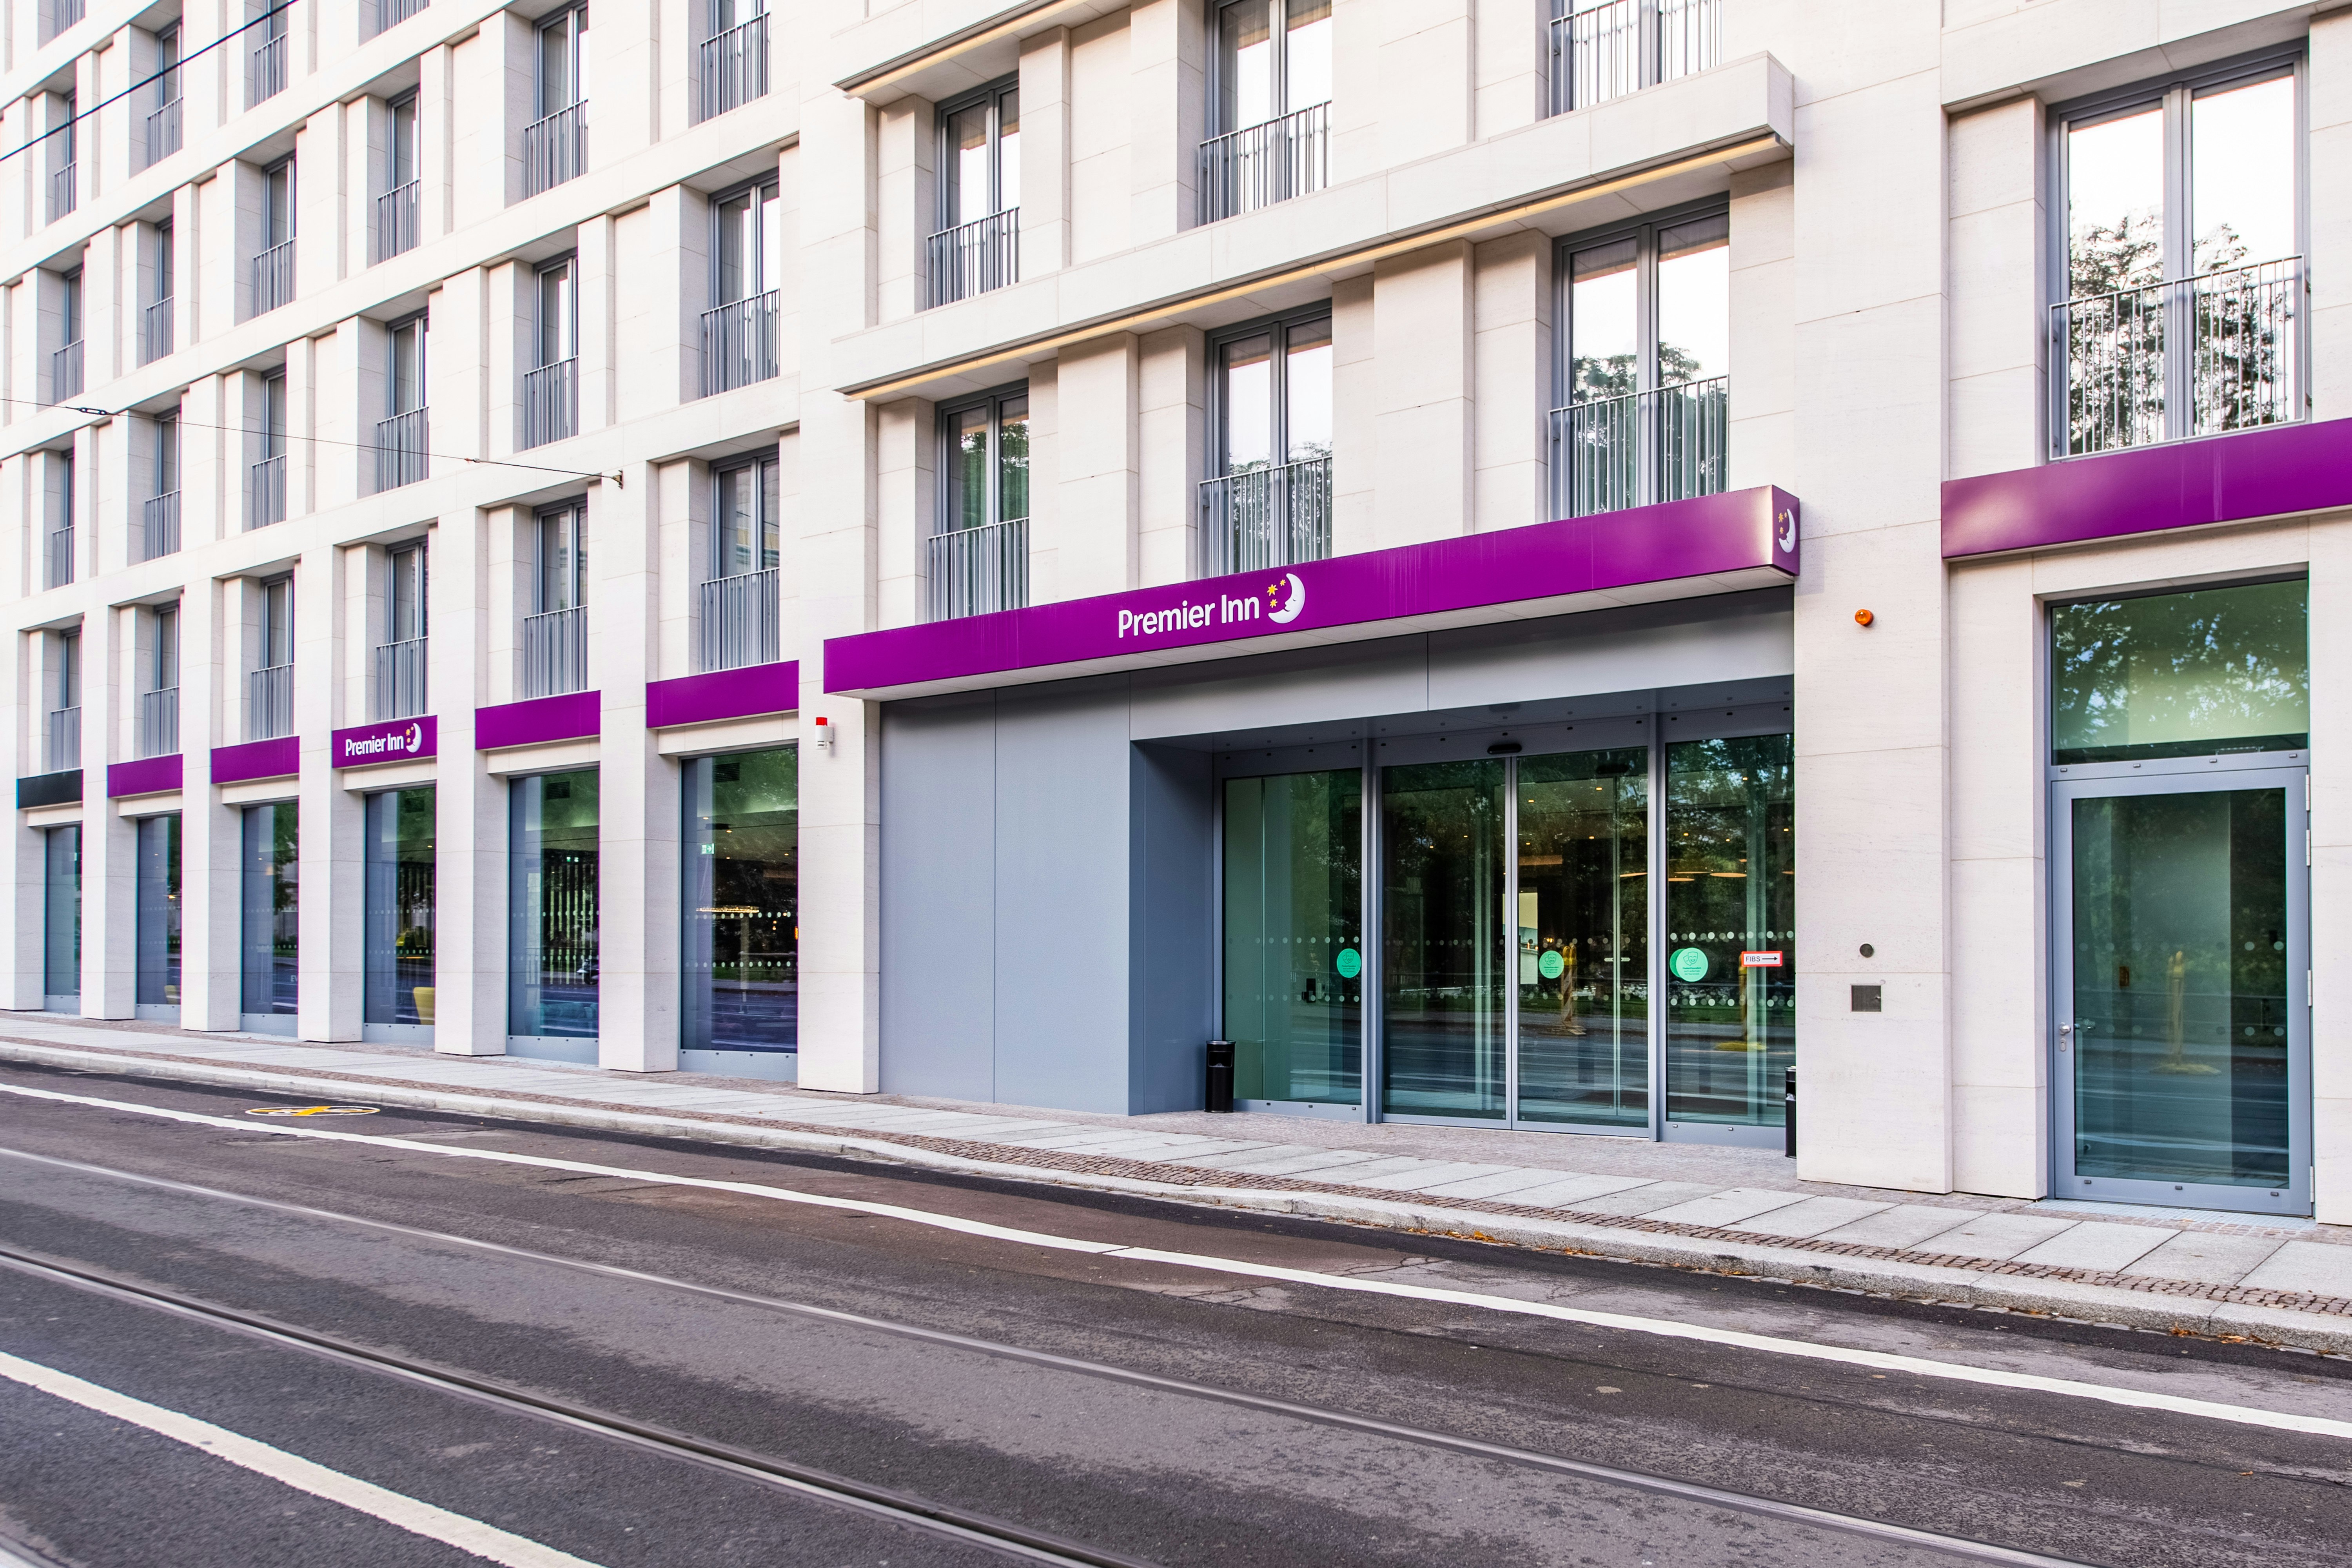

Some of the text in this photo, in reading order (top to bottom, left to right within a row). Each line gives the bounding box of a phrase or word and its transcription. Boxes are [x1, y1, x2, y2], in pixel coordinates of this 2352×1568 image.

[1118, 594, 1259, 639] Premier Inn
[345, 733, 404, 757] Premier Inn
